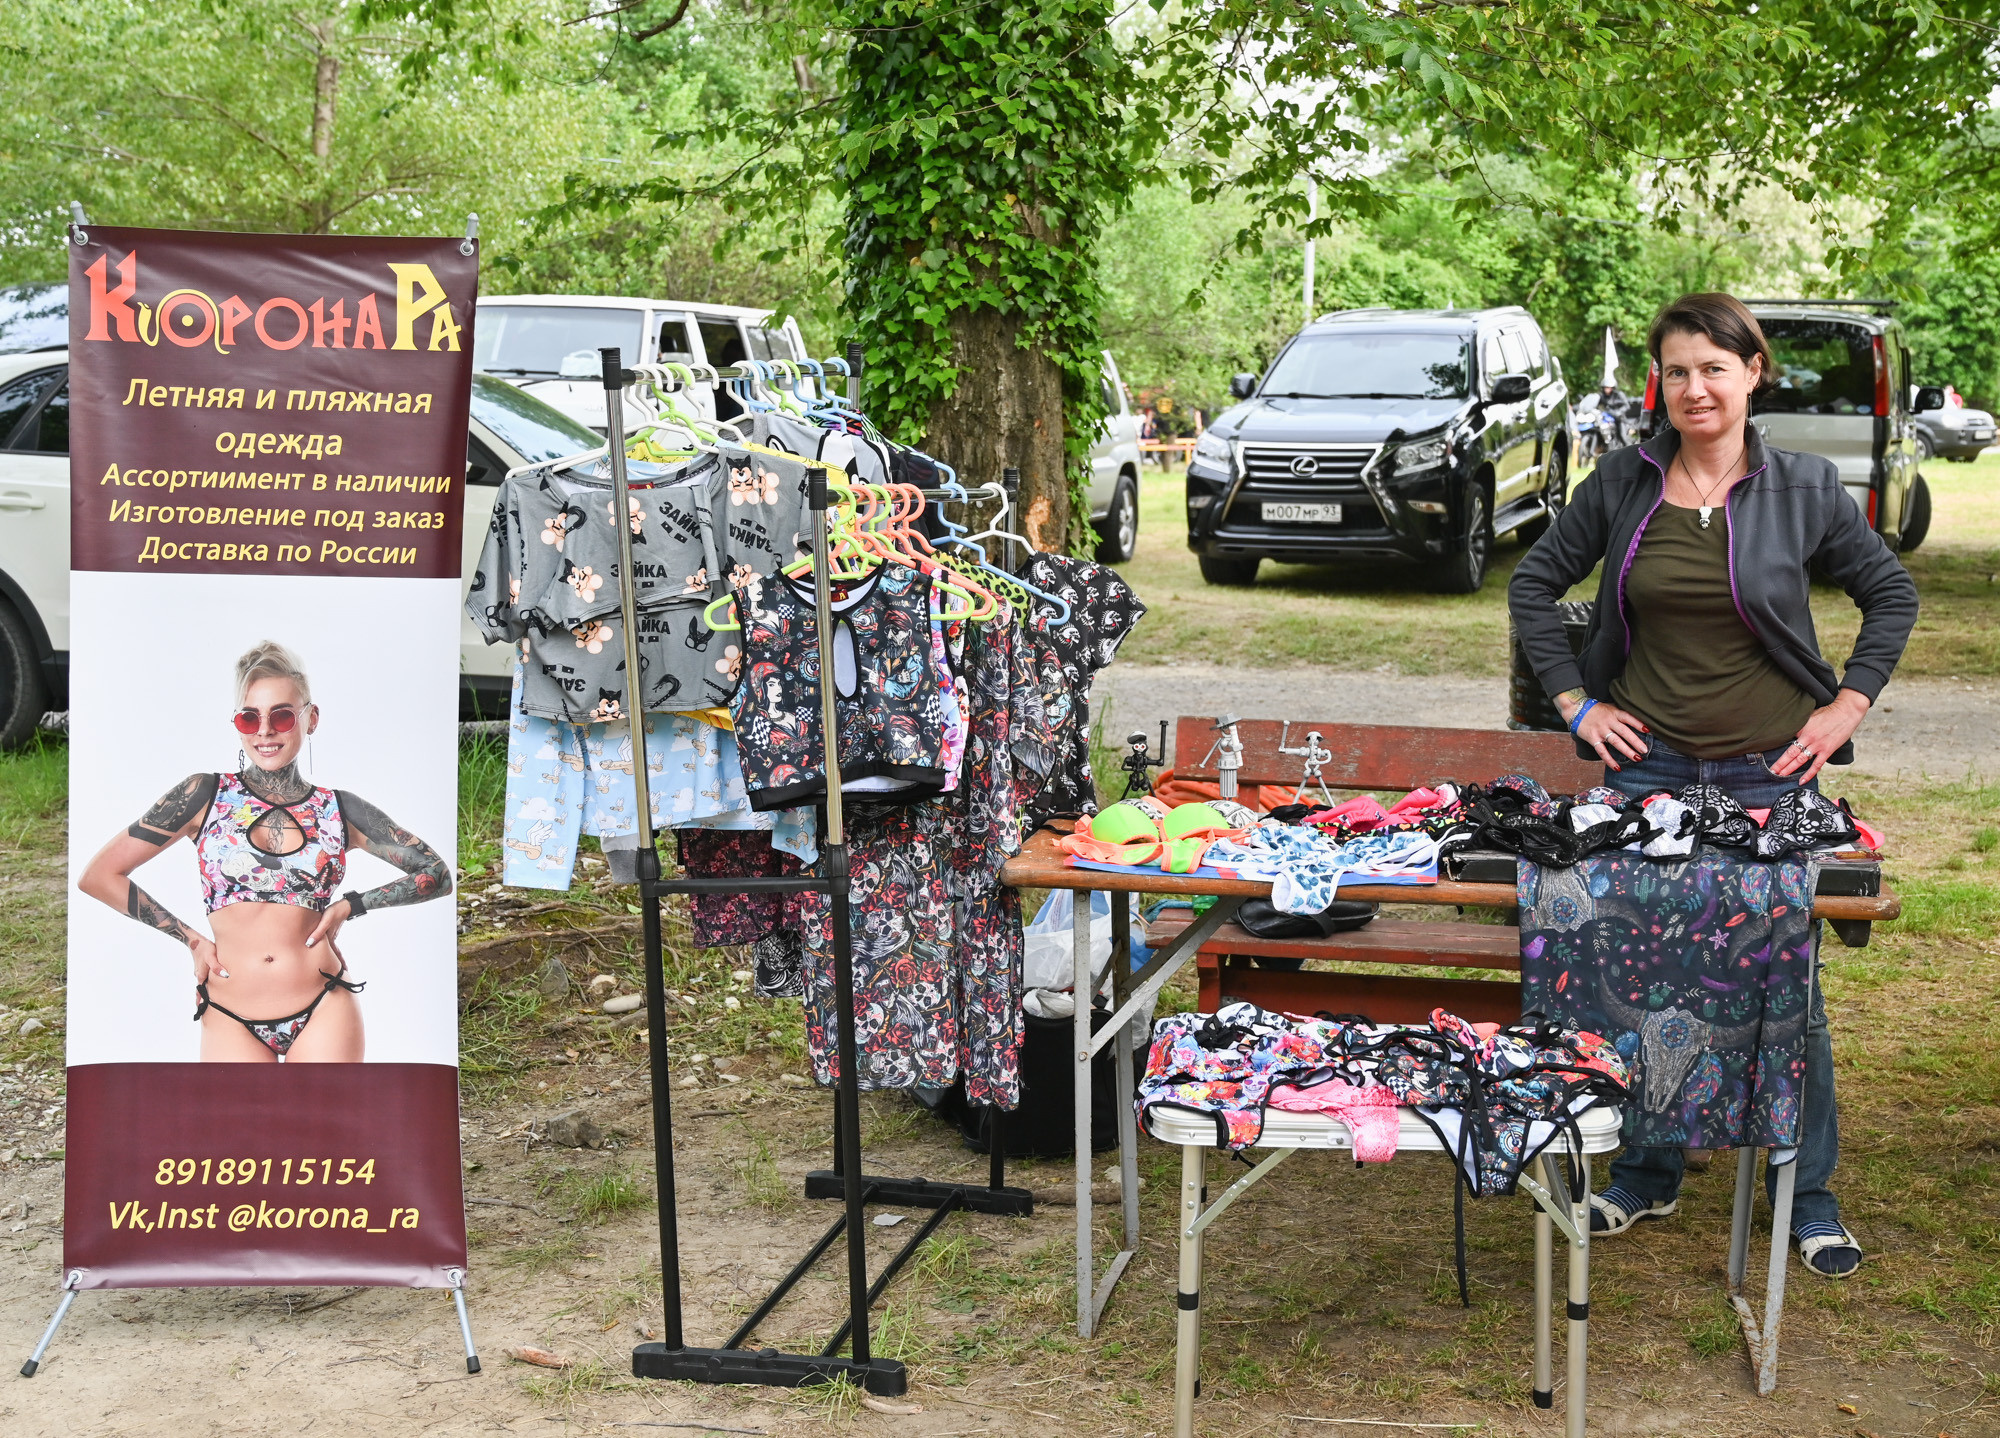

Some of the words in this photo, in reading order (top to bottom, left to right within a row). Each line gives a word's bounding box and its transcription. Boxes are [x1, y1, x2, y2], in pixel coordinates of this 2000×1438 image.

[122, 378, 245, 409] Летняя
[255, 388, 276, 410] и
[286, 389, 433, 414] пляжная
[215, 431, 343, 460] одежда
[100, 463, 305, 493] Ассортиимент
[312, 473, 328, 491] в
[335, 474, 451, 494] наличии
[108, 499, 307, 527] Изготовление
[313, 509, 365, 532] под
[372, 510, 445, 529] заказ
[1323, 506, 1336, 516] 93
[137, 536, 269, 564] Доставка
[276, 544, 312, 563] по
[319, 539, 417, 565] России
[610, 561, 668, 578] ЗЙКА
[154, 1158, 376, 1186] 89189115154
[108, 1200, 219, 1234] Vk,Inst
[227, 1200, 420, 1233] @korona_ra
